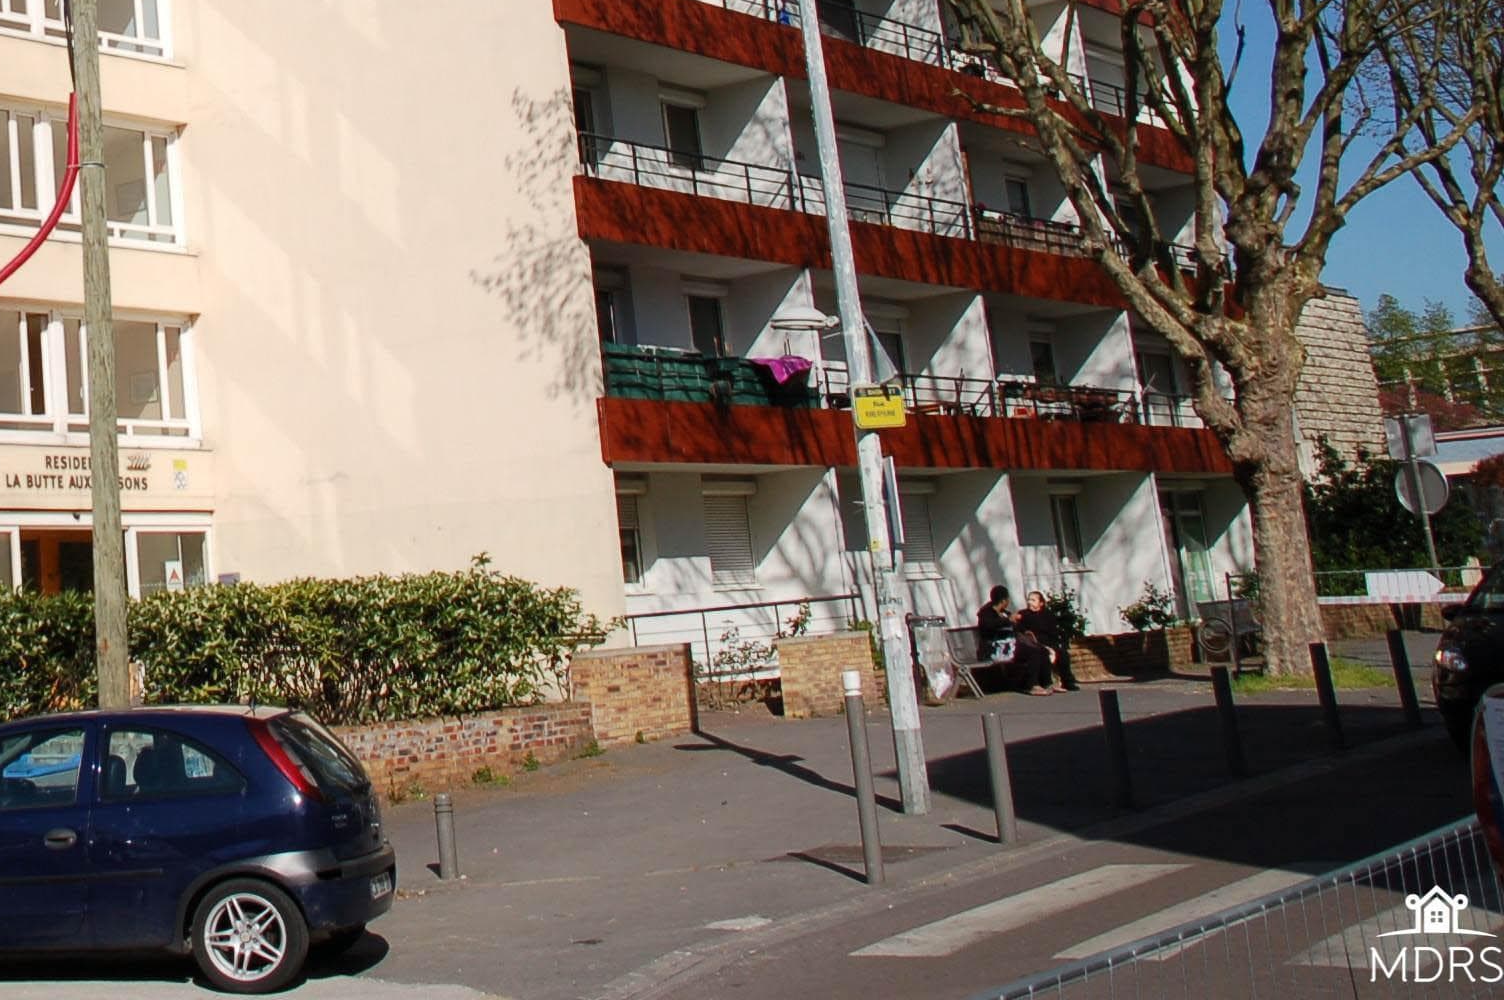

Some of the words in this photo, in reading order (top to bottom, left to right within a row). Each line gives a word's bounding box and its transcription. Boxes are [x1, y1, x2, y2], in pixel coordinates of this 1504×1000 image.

[45, 455, 91, 470] RESIDE
[5, 473, 21, 489] LA
[26, 474, 64, 489] BUTTE
[69, 475, 92, 489] AUX
[118, 476, 148, 490] SONS
